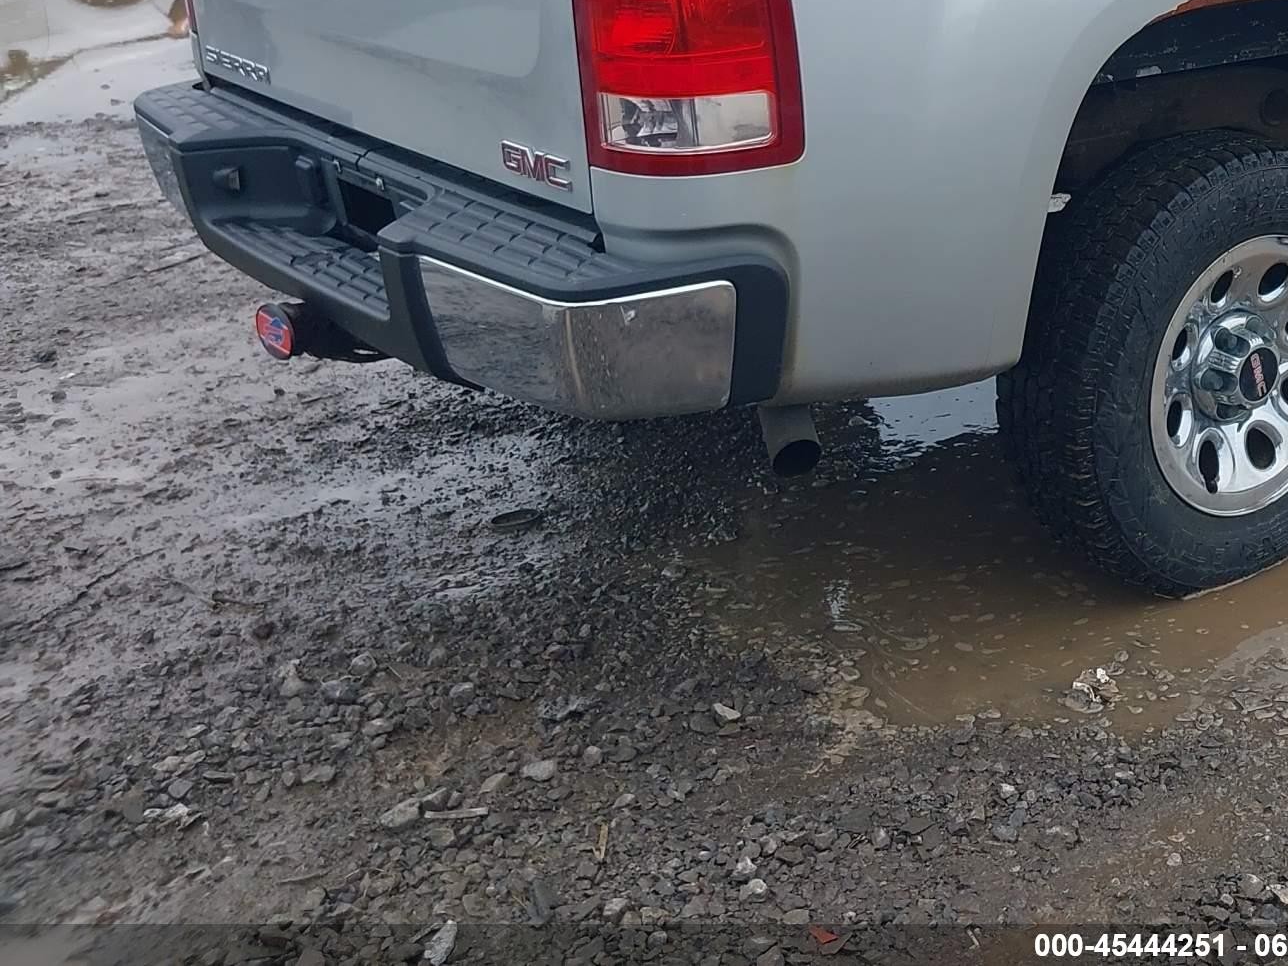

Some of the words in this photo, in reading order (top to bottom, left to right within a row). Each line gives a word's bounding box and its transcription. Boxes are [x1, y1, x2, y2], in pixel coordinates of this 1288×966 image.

[205, 44, 271, 85] SIERRA
[500, 139, 573, 193] GMC
[1250, 353, 1267, 397] GMC
